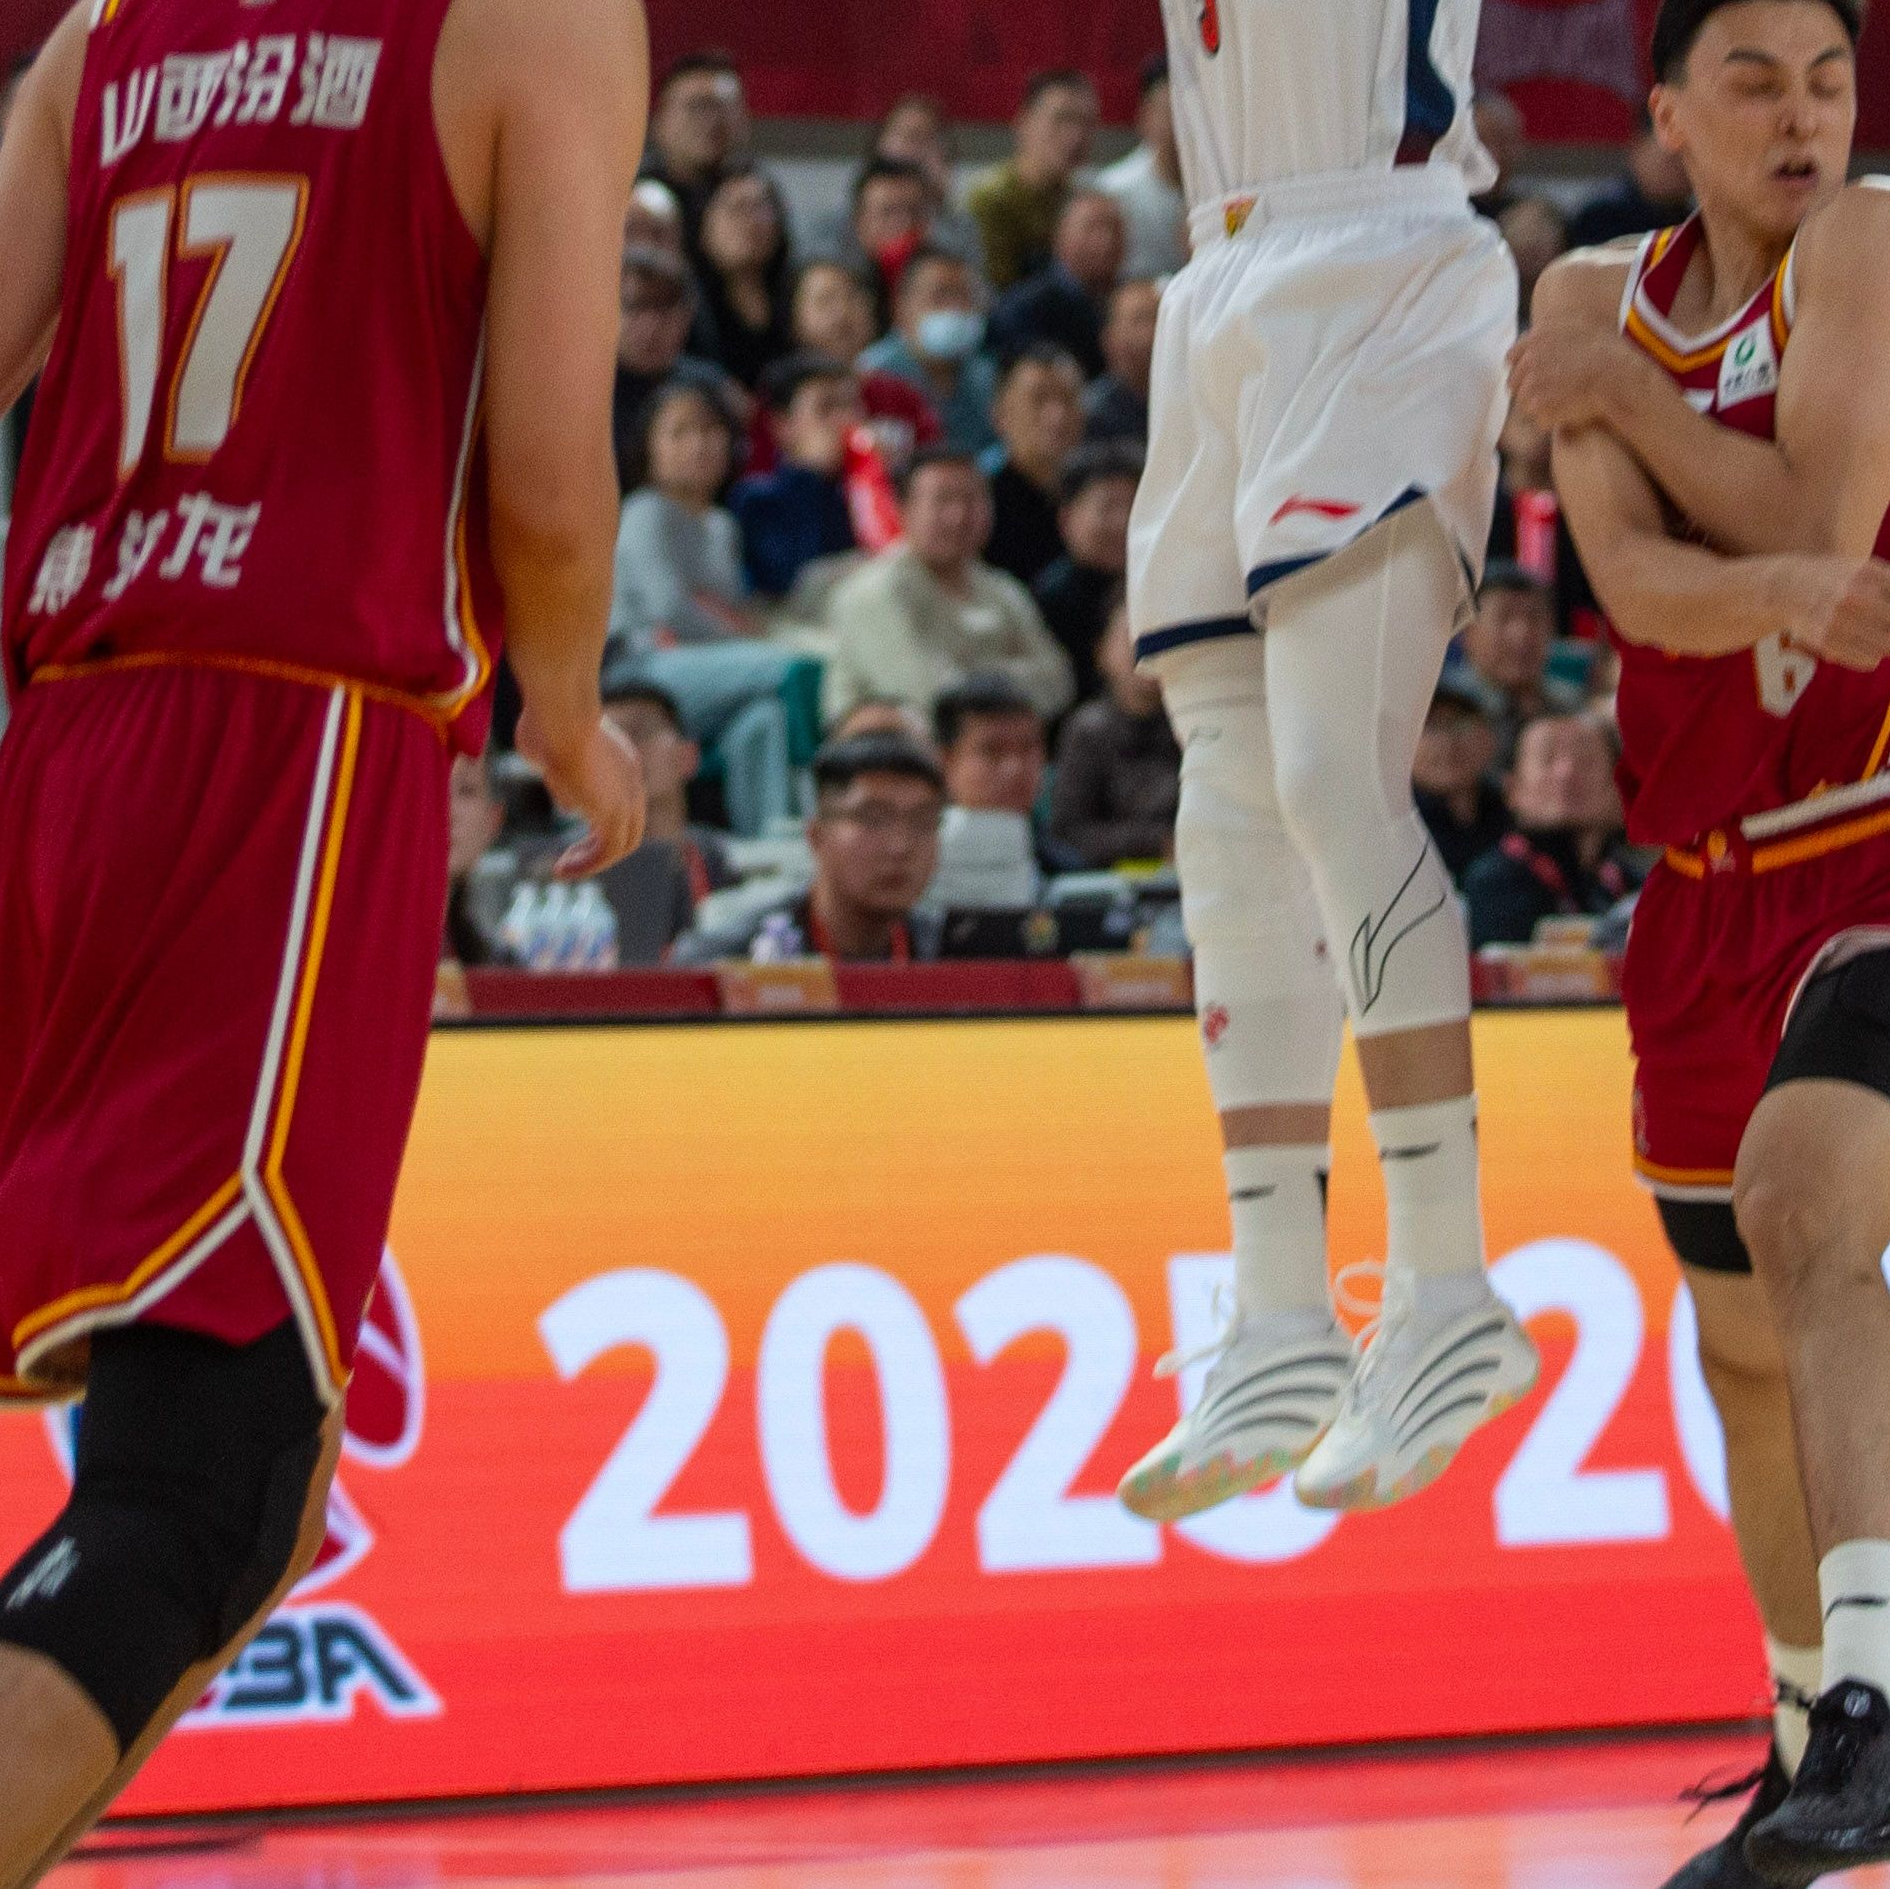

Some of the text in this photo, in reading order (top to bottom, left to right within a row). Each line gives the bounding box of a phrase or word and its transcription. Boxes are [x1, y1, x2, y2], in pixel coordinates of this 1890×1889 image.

[100, 32, 383, 168] 山西汾酒
[107, 170, 310, 482] 17
[183, 1606, 444, 1726] BA
